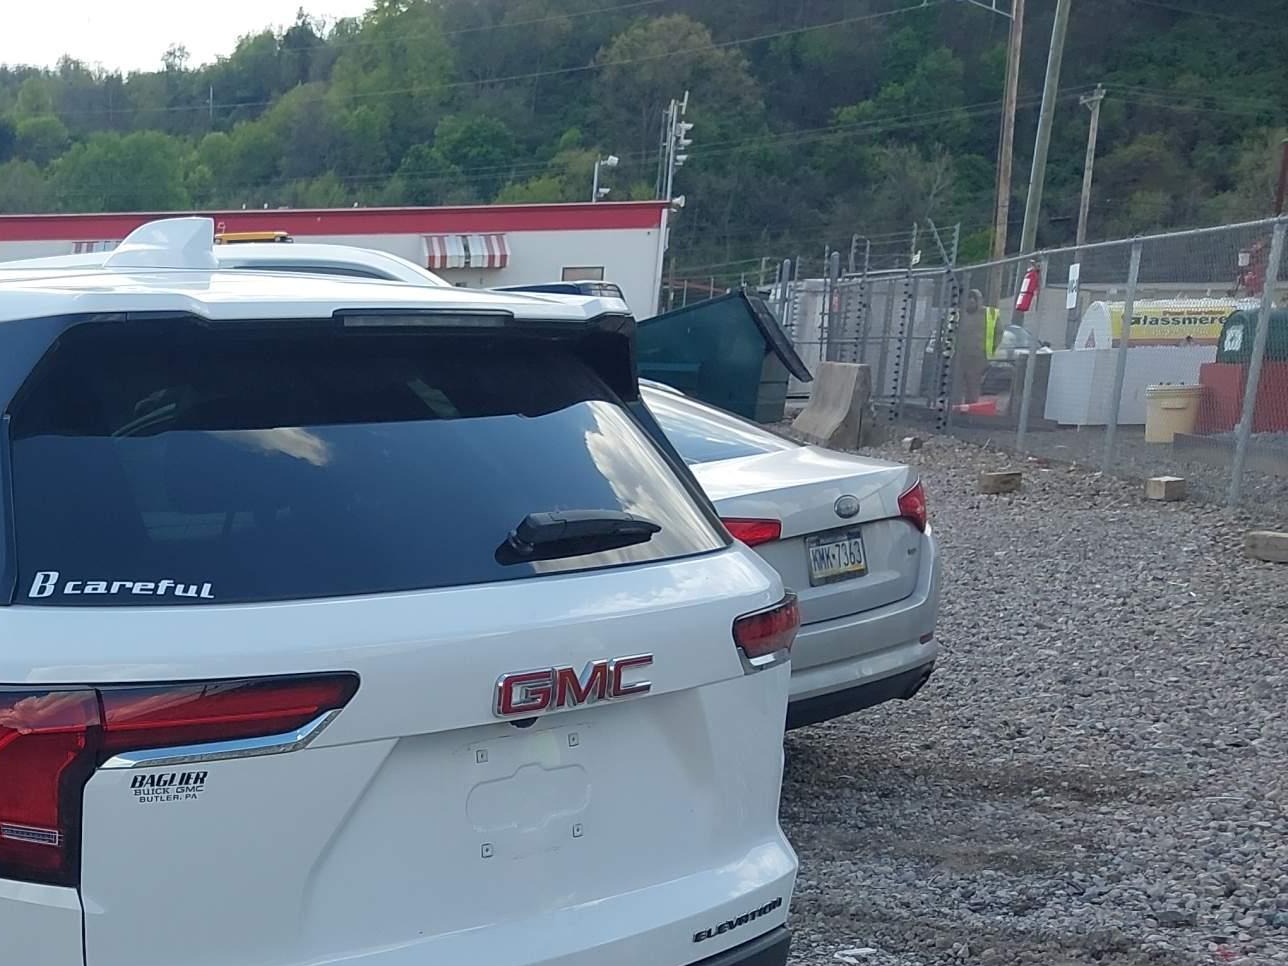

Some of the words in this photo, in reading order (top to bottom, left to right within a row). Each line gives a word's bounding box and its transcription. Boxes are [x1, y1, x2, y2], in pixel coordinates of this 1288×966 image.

[28, 571, 60, 598] B
[492, 652, 654, 718] GMC
[130, 771, 208, 789] BAGLIER
[134, 787, 170, 796] BUICK
[176, 785, 204, 794] GMC
[693, 896, 782, 943] ELEVATION
